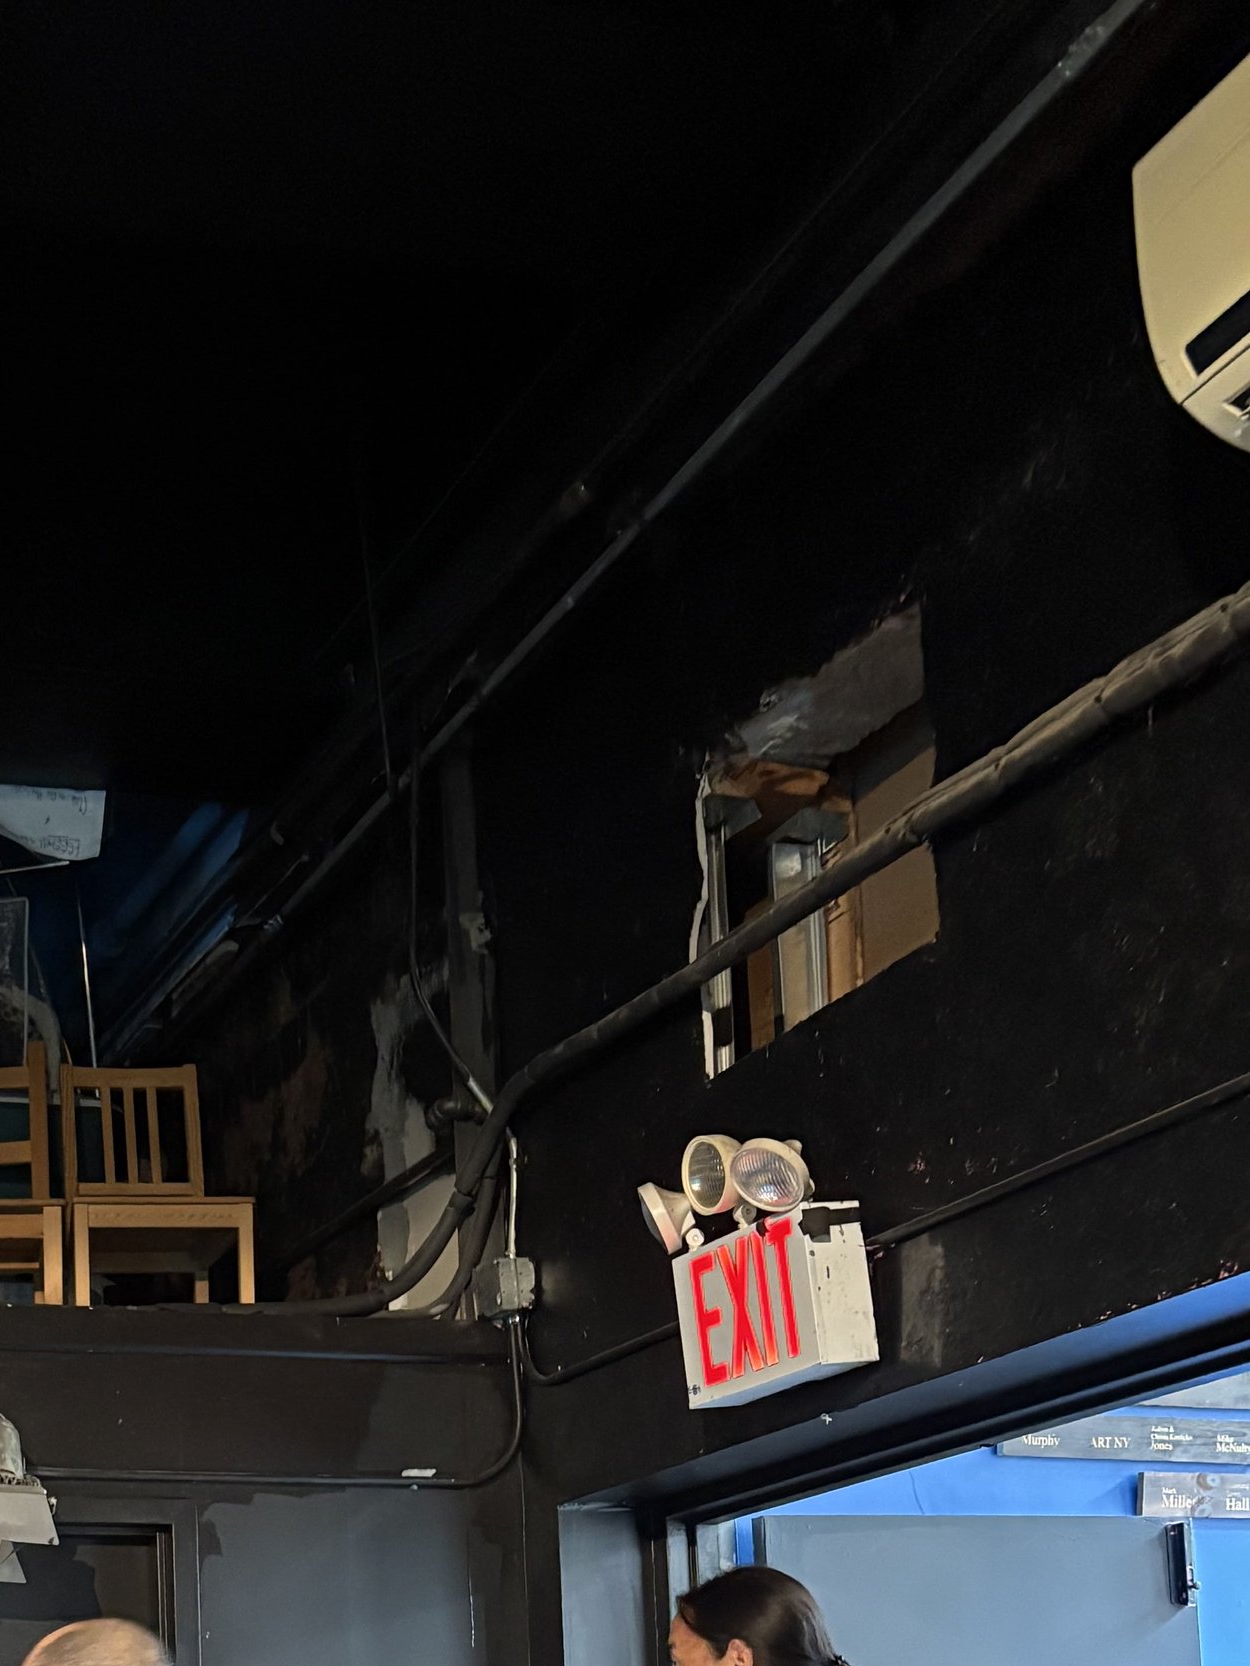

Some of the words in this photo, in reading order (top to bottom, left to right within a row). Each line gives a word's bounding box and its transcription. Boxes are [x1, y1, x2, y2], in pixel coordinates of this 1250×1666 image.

[688, 1216, 801, 1387] EXIT
[1021, 1433, 1061, 1449] Murphy
[1090, 1436, 1112, 1449] ART
[1113, 1436, 1131, 1449] NY
[1225, 1497, 1250, 1511] Hall
